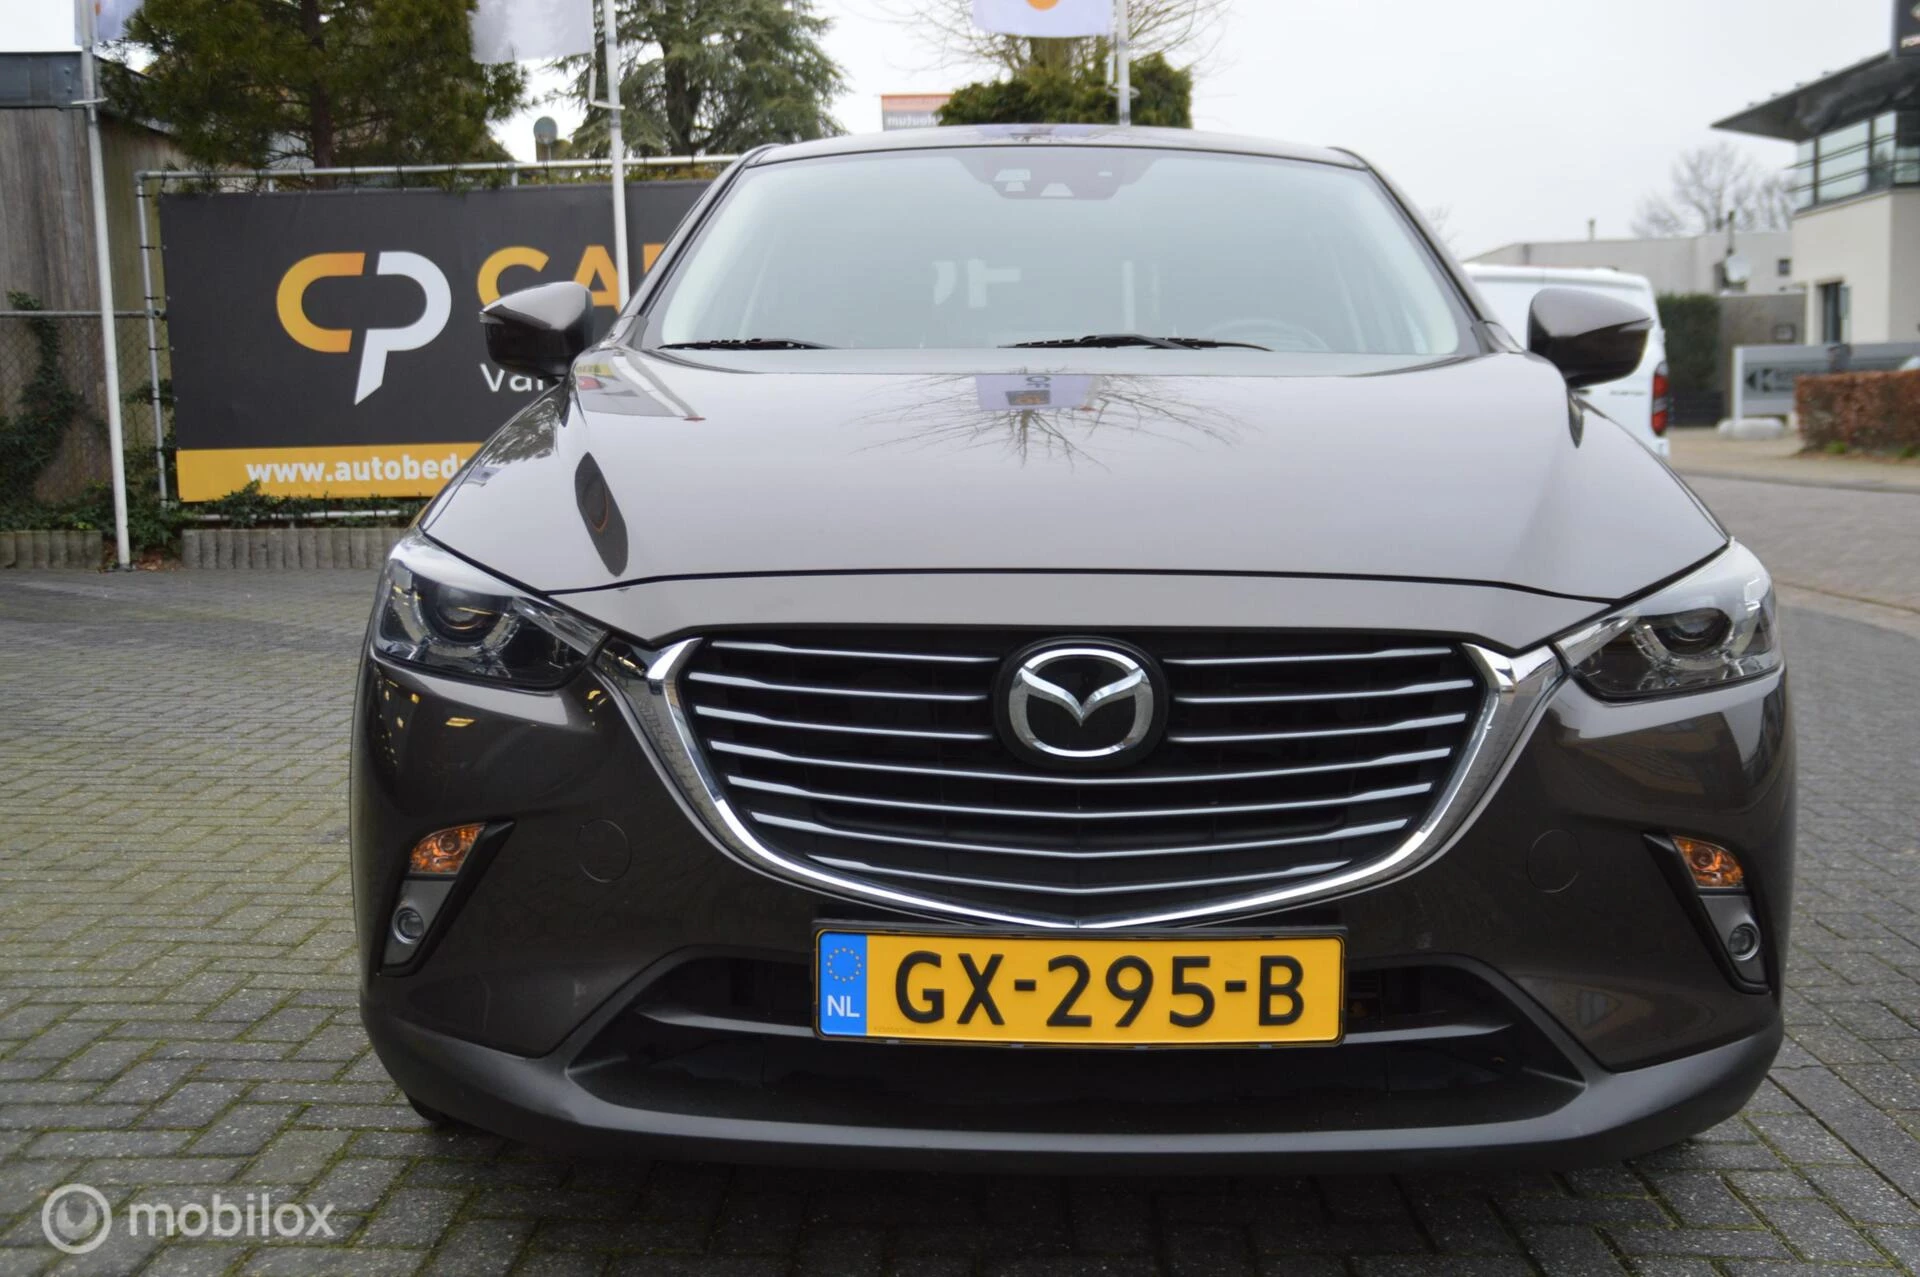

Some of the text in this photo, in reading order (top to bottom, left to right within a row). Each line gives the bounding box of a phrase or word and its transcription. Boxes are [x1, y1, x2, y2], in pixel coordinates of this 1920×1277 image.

[477, 244, 666, 314] CA
[246, 454, 467, 483] www.autobed
[828, 995, 860, 1018] NL
[895, 951, 1304, 1028] GX-295-B
